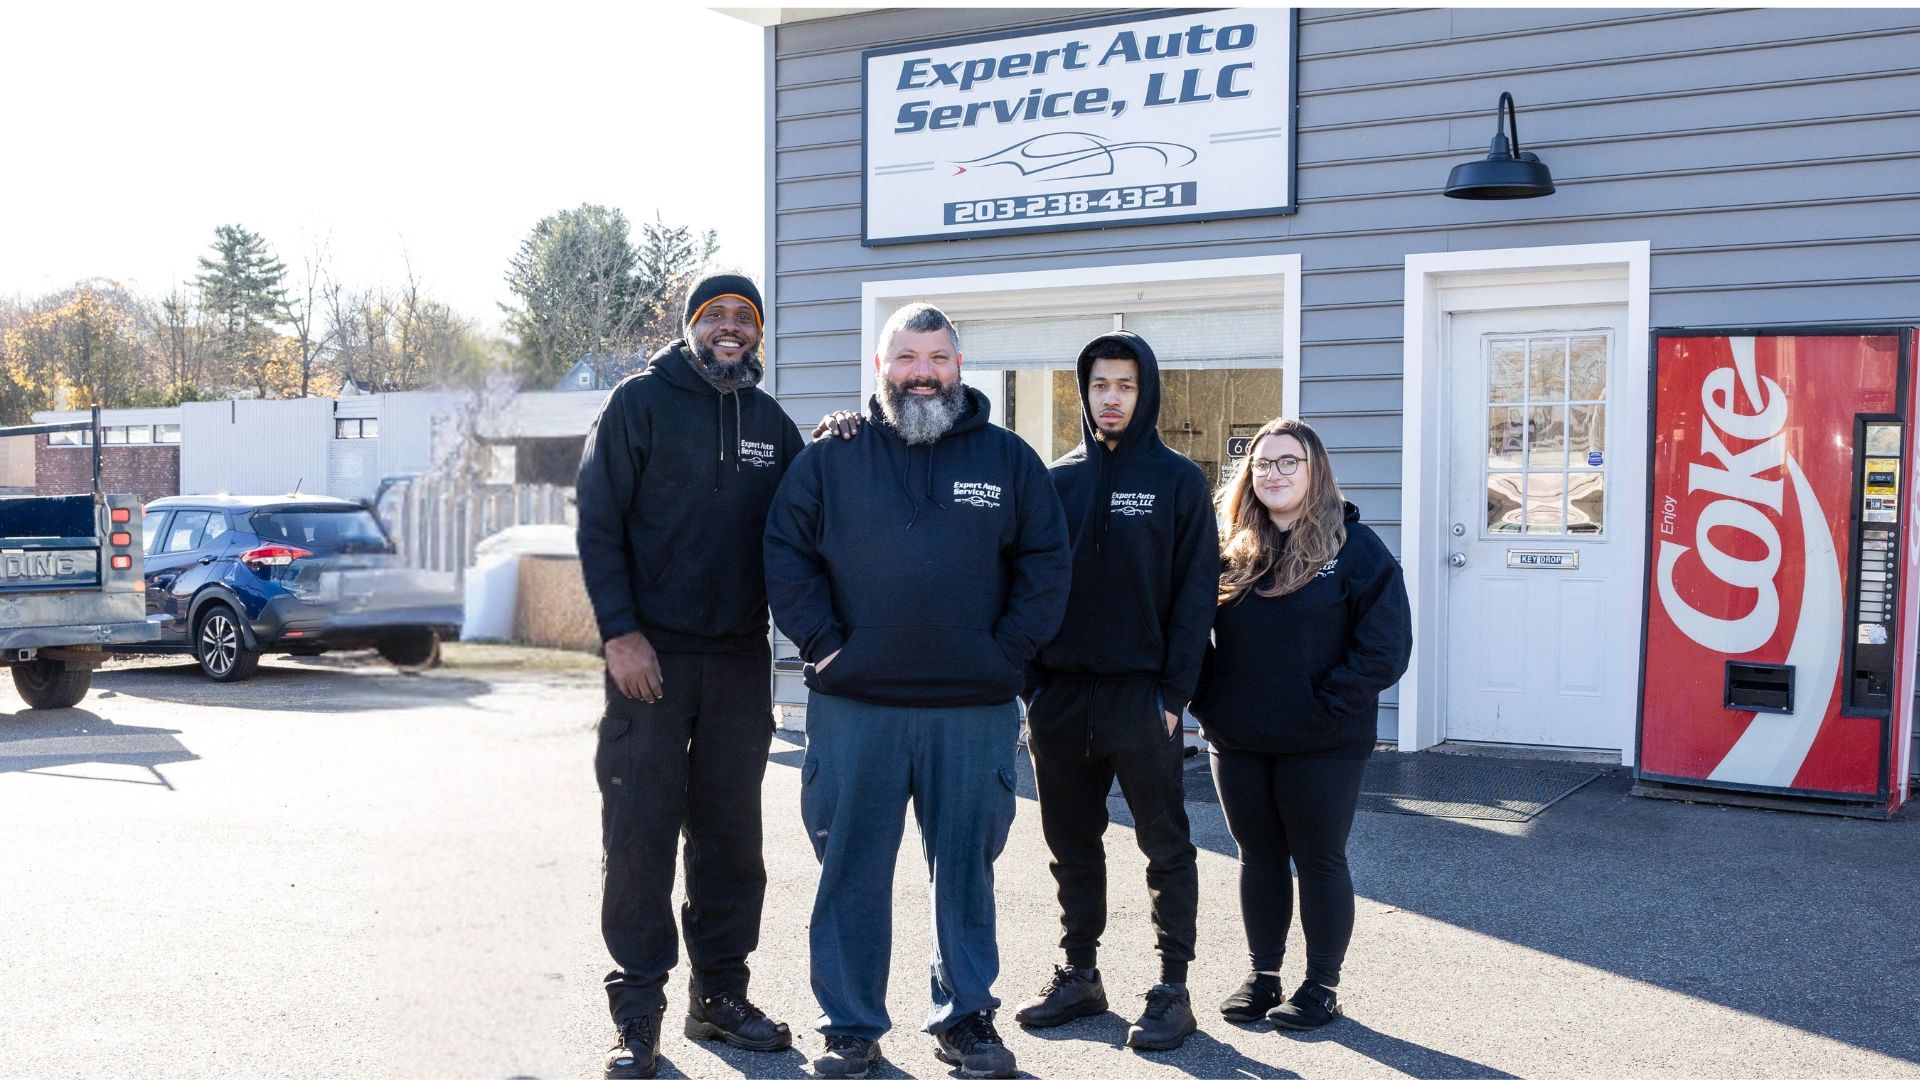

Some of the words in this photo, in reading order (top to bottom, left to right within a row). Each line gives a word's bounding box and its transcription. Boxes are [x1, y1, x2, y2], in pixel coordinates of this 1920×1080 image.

[896, 39, 1090, 92] Expert
[1097, 23, 1257, 67] Auto
[894, 87, 1128, 134] Service,
[1143, 62, 1256, 107] LLC
[954, 184, 1184, 223] 203-238-4321
[741, 439, 760, 449] Expert
[761, 442, 774, 450] Auto
[953, 489, 987, 498] Service,
[987, 491, 1001, 499] LLC
[983, 483, 1002, 492] Auto
[1657, 367, 1788, 654] Coke
[1660, 496, 1677, 535] Enjoy
[1521, 555, 1537, 563] KEY
[1540, 556, 1562, 564] DROP
